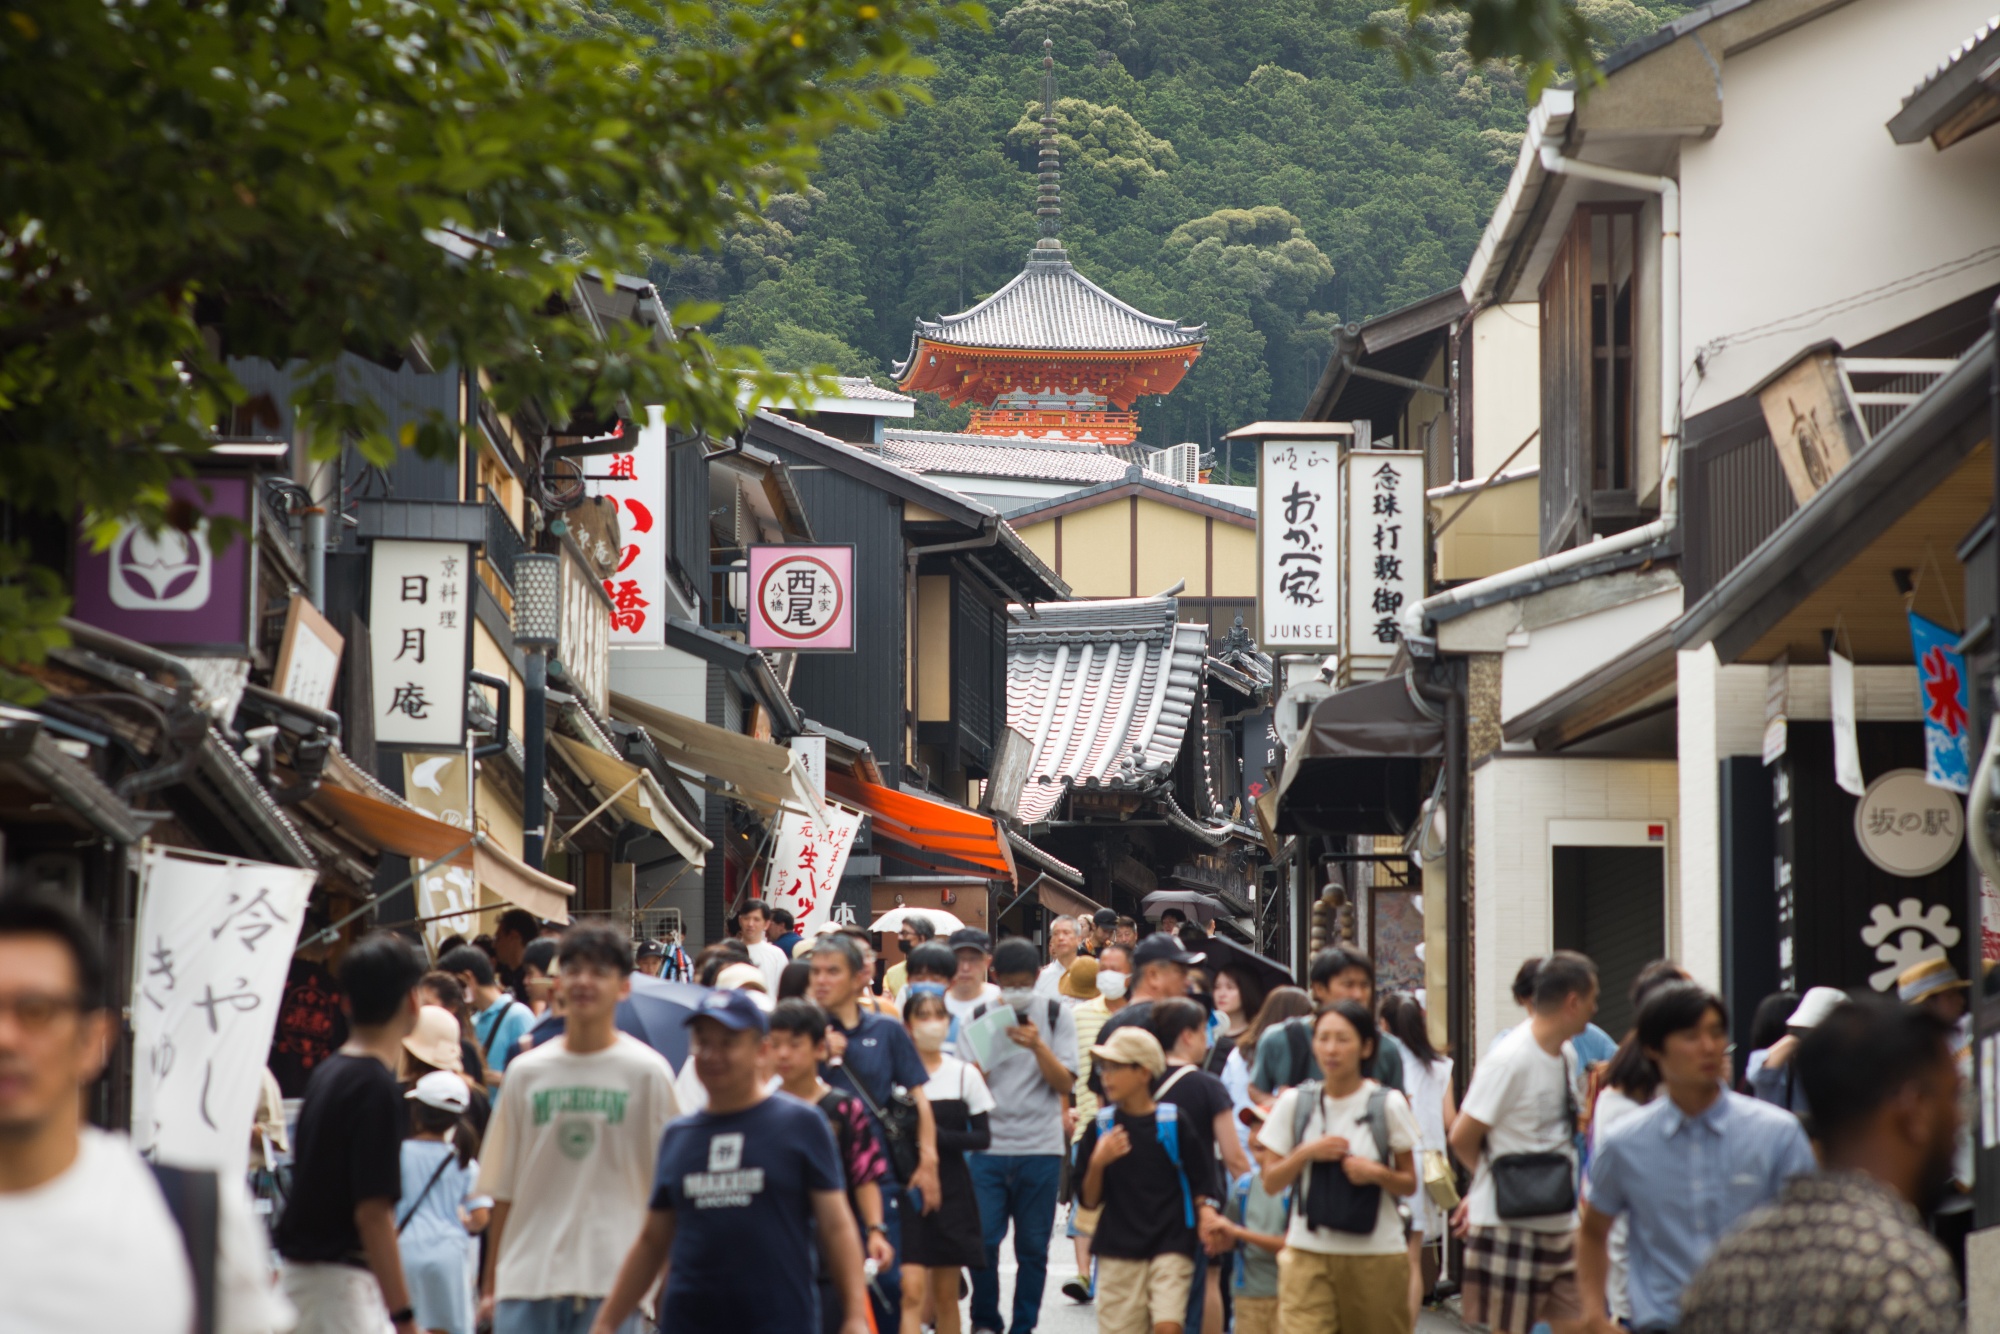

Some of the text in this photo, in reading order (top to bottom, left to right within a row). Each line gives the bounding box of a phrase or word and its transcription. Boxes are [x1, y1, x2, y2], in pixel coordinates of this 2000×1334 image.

[1278, 481, 1324, 608] おかべ家
[438, 555, 459, 629] 京料理
[782, 569, 818, 626] 西尾
[818, 583, 832, 612] 本家
[385, 574, 434, 720] 日月庵
[1270, 624, 1335, 639] JUNSEI
[1920, 645, 1968, 738] 氷
[1867, 806, 1955, 837] 坂の駅
[773, 869, 789, 909] やつはし
[820, 826, 850, 891] ほんまもん
[193, 887, 289, 1132] 冷やし
